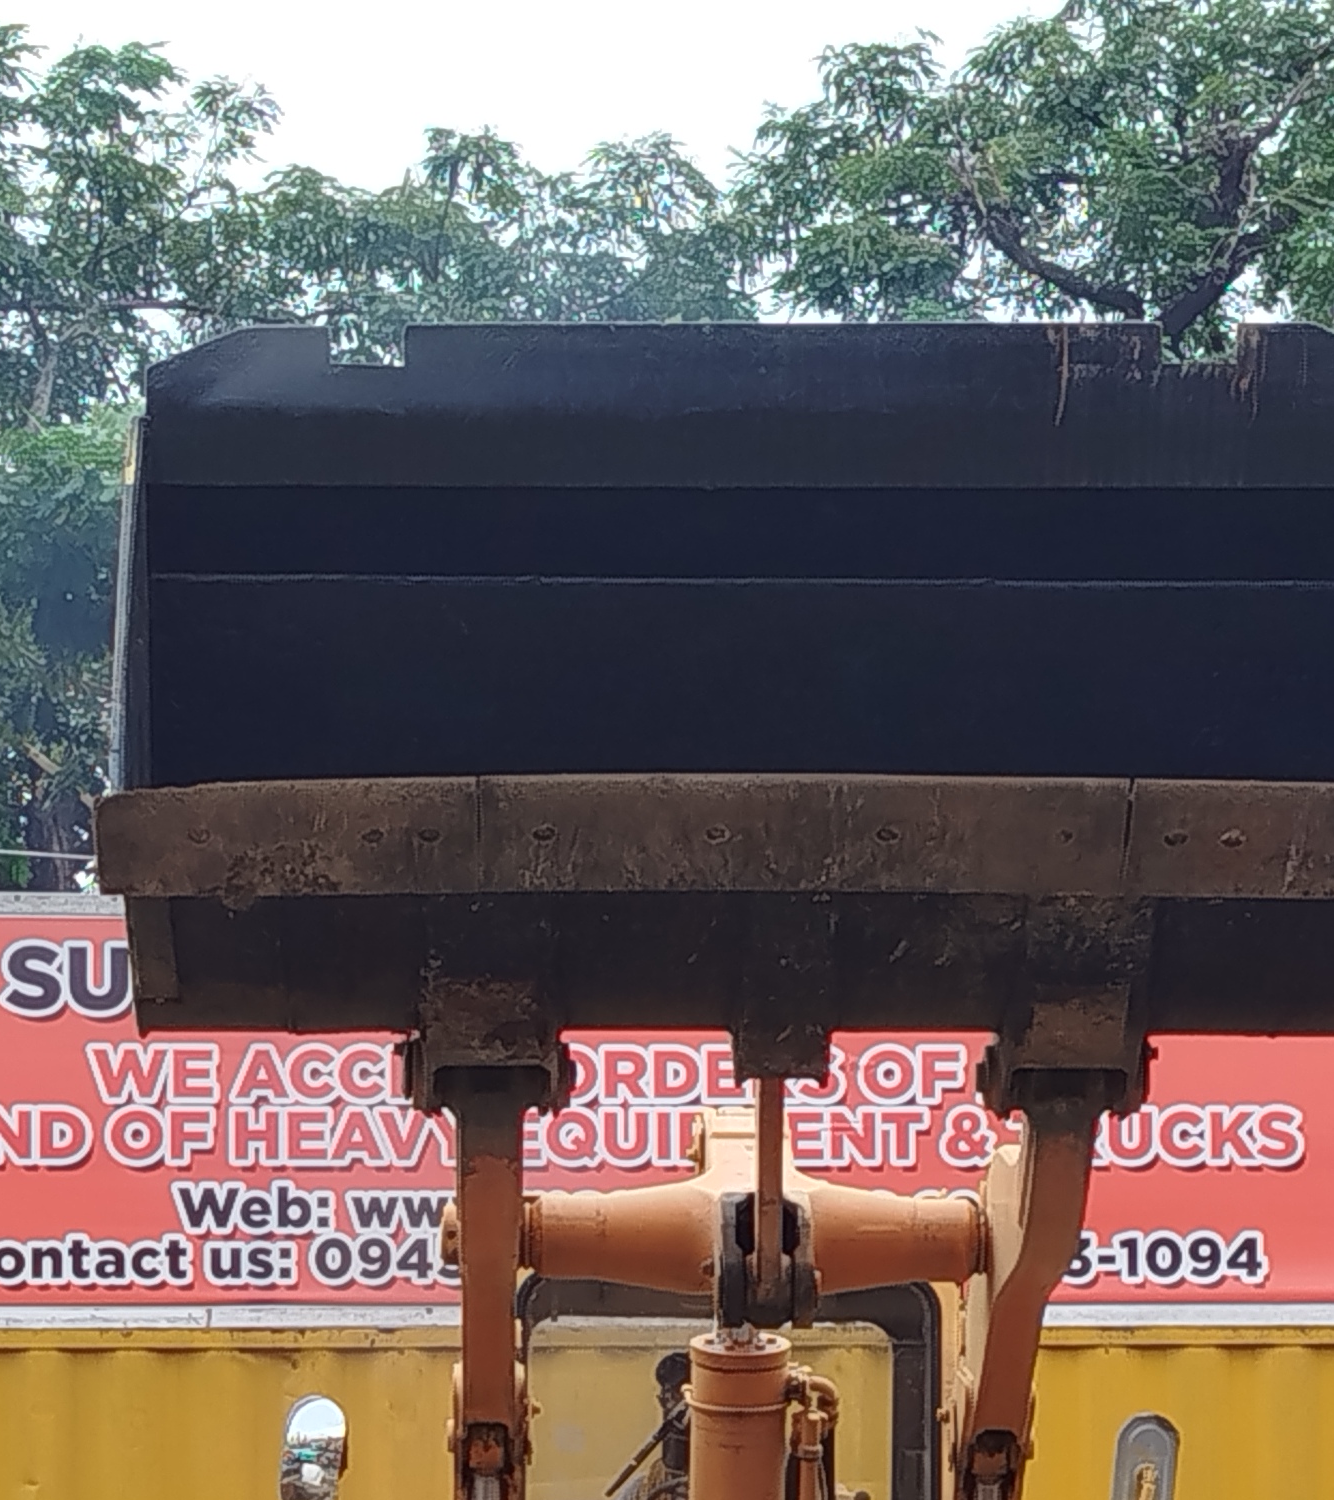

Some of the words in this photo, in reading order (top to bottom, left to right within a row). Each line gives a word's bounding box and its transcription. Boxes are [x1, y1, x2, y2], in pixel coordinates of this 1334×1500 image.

[2, 940, 132, 1015] SU
[87, 1045, 217, 1102] WE
[859, 1044, 963, 1103] OF
[106, 1105, 214, 1166] OF
[942, 1105, 993, 1166] &
[175, 1183, 332, 1231] Web:
[208, 1244, 295, 1282] us:
